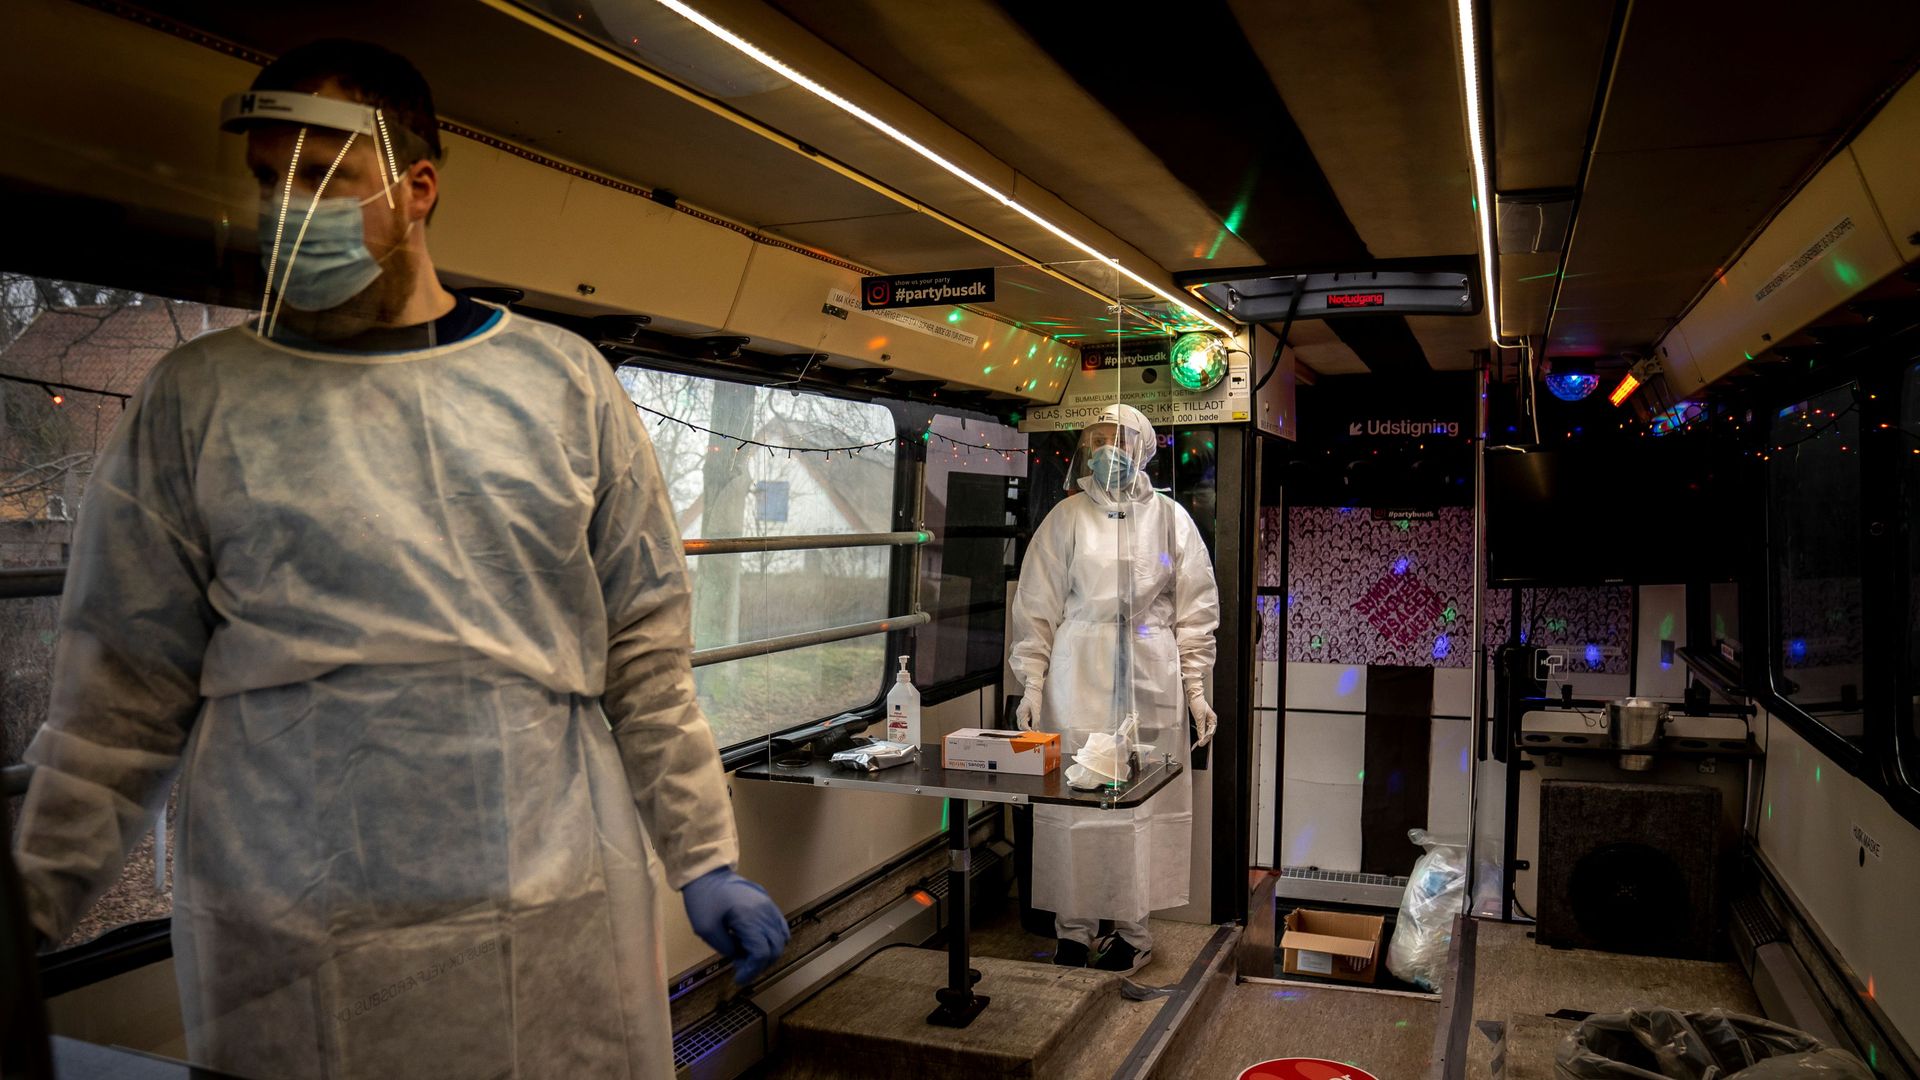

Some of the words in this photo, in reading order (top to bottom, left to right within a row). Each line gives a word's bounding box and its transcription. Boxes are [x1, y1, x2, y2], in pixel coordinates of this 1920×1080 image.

[934, 276, 951, 285] party
[895, 282, 986, 304] #partybusdk
[1065, 407, 1103, 418] SHOTG
[1157, 402, 1180, 413] IKKE
[1183, 400, 1225, 411] TILLADT
[1054, 421, 1085, 429] Rygning
[1367, 419, 1459, 437] Udstigning
[1388, 510, 1434, 519] #partybusdk
